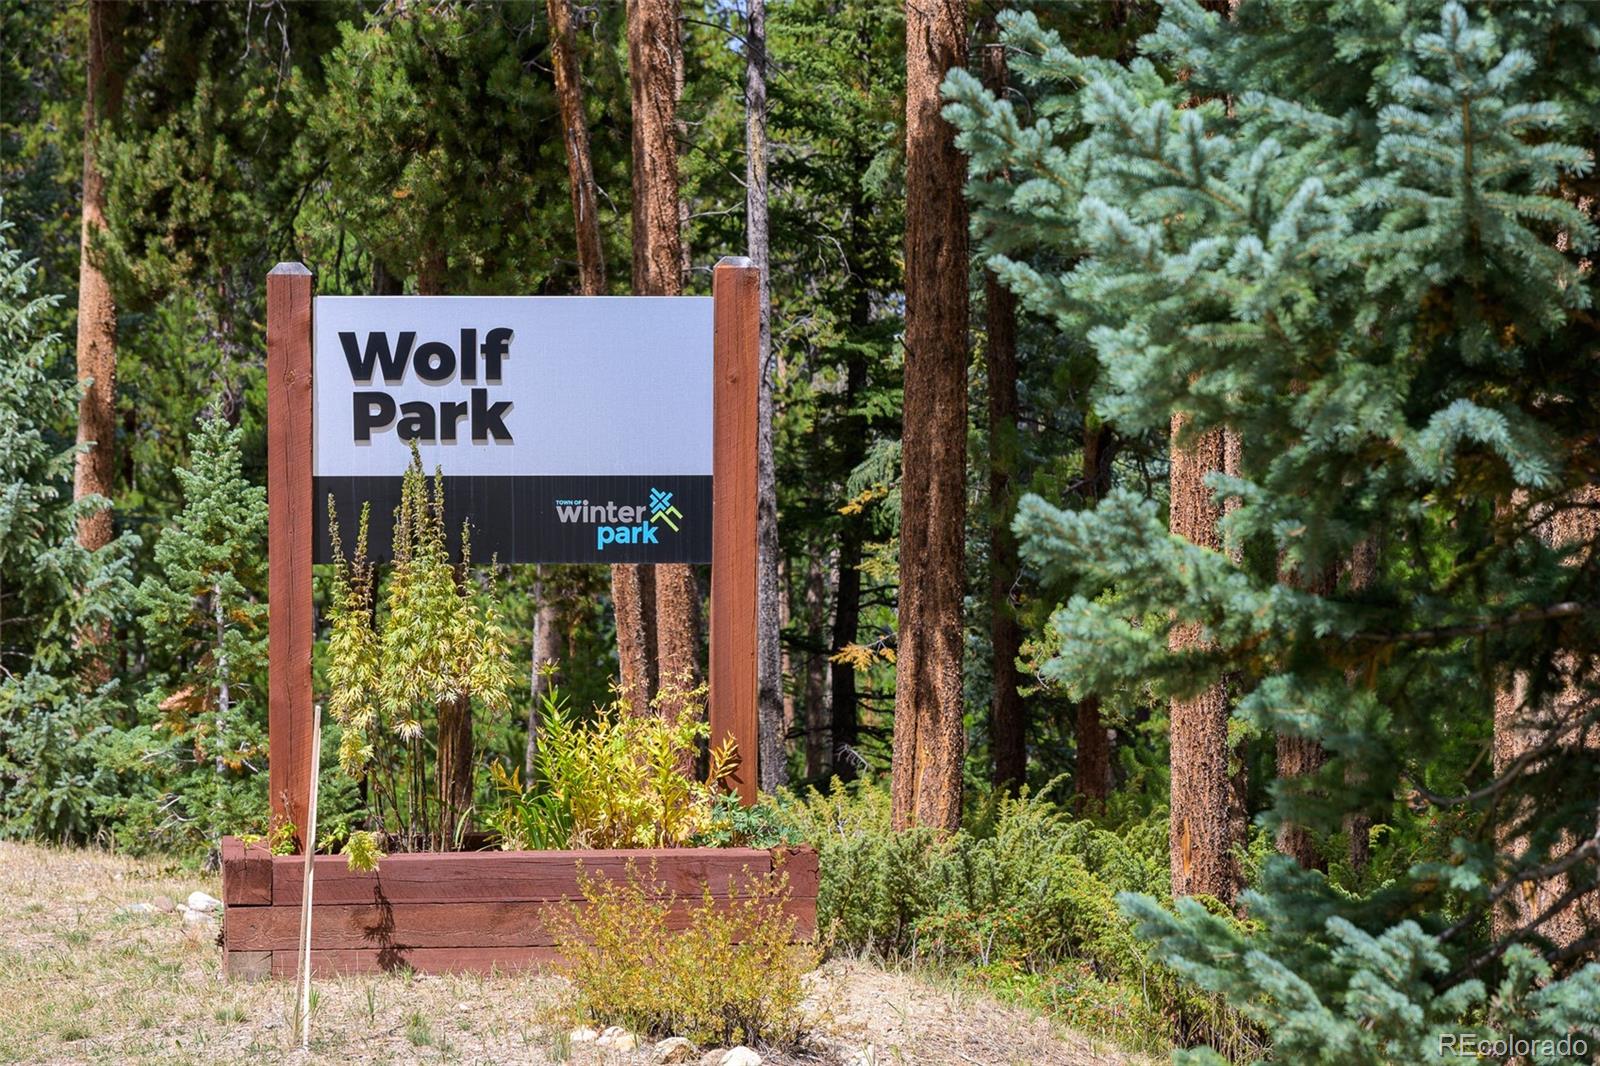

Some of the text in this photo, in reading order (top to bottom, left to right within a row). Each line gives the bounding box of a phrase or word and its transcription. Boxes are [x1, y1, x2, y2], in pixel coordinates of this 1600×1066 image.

[338, 327, 514, 382] Wolf
[353, 388, 514, 441] Park
[556, 499, 647, 523] winter
[597, 521, 659, 550] park
